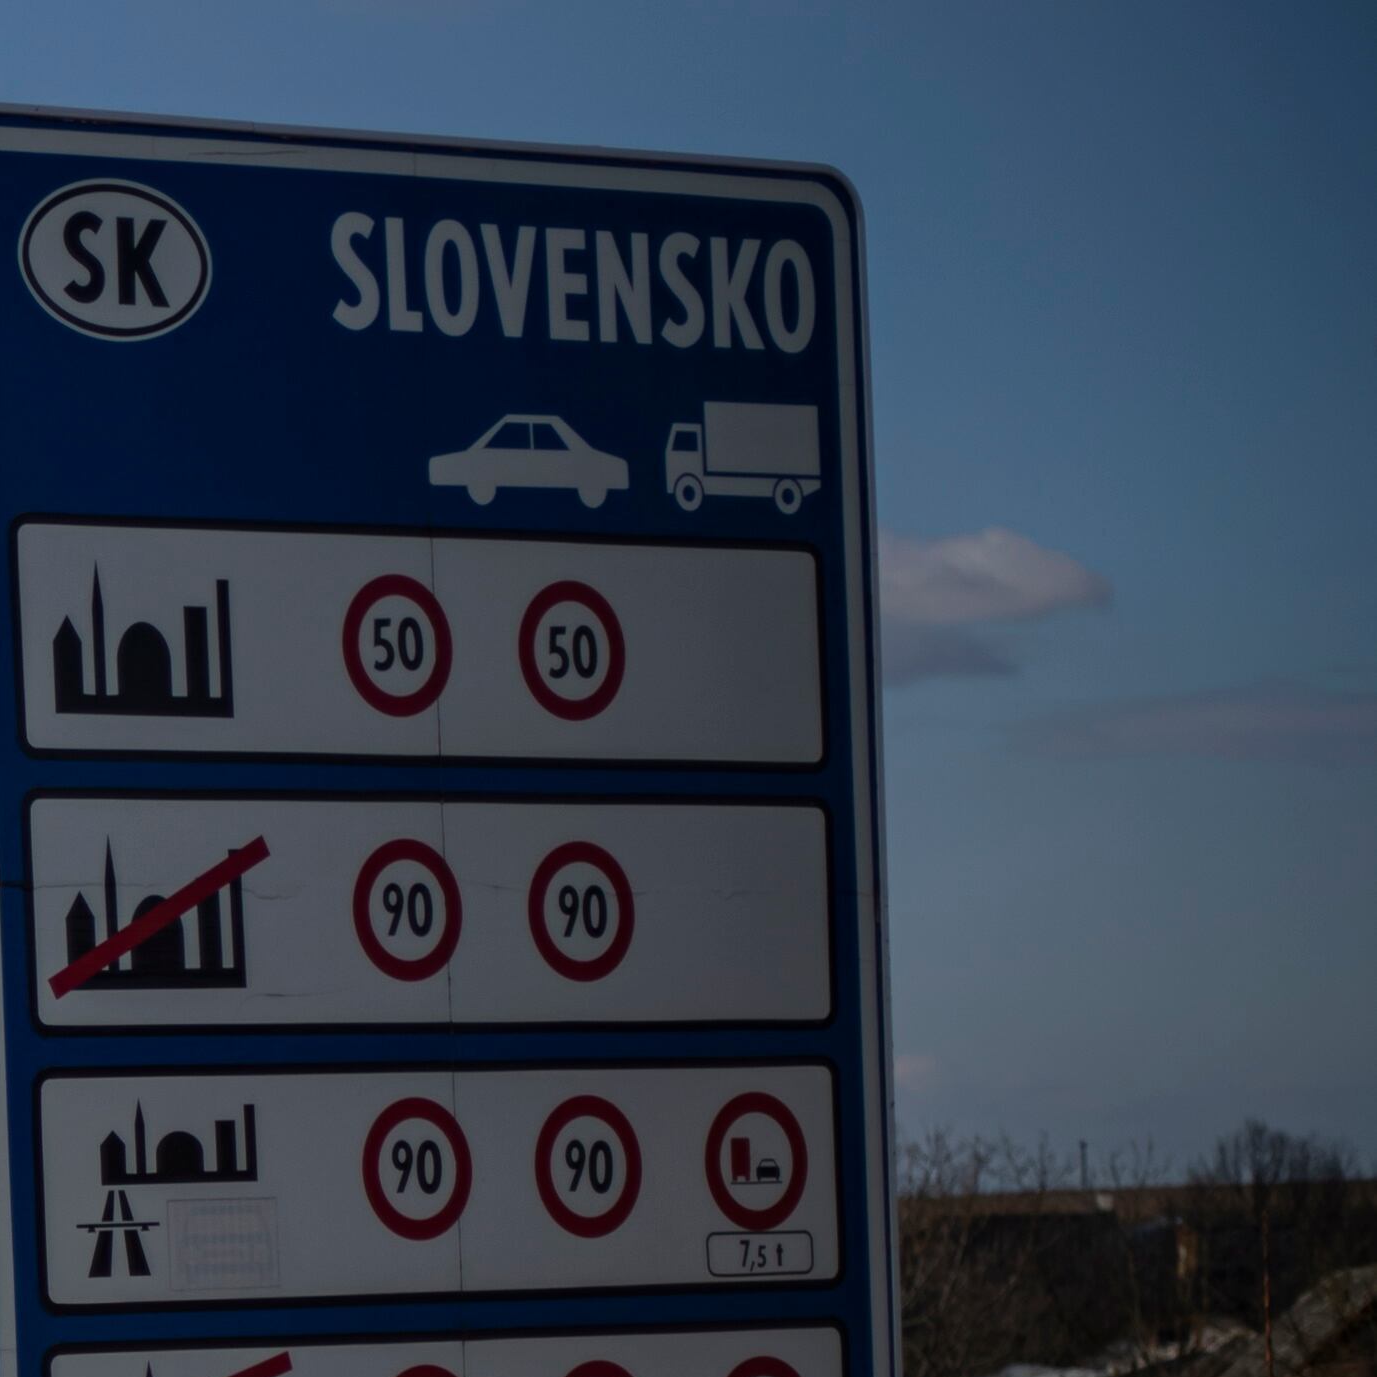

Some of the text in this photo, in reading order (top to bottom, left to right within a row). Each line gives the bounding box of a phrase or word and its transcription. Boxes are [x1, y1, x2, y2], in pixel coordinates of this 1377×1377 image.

[62, 210, 170, 309] SK
[329, 210, 817, 354] SLOVENSKO
[373, 616, 424, 672] 50
[548, 624, 598, 679] 50
[382, 882, 433, 938] 90
[558, 884, 608, 939] 90
[391, 1139, 443, 1195] 90
[564, 1138, 614, 1195] 90
[739, 1239, 784, 1272] 7,5 t
